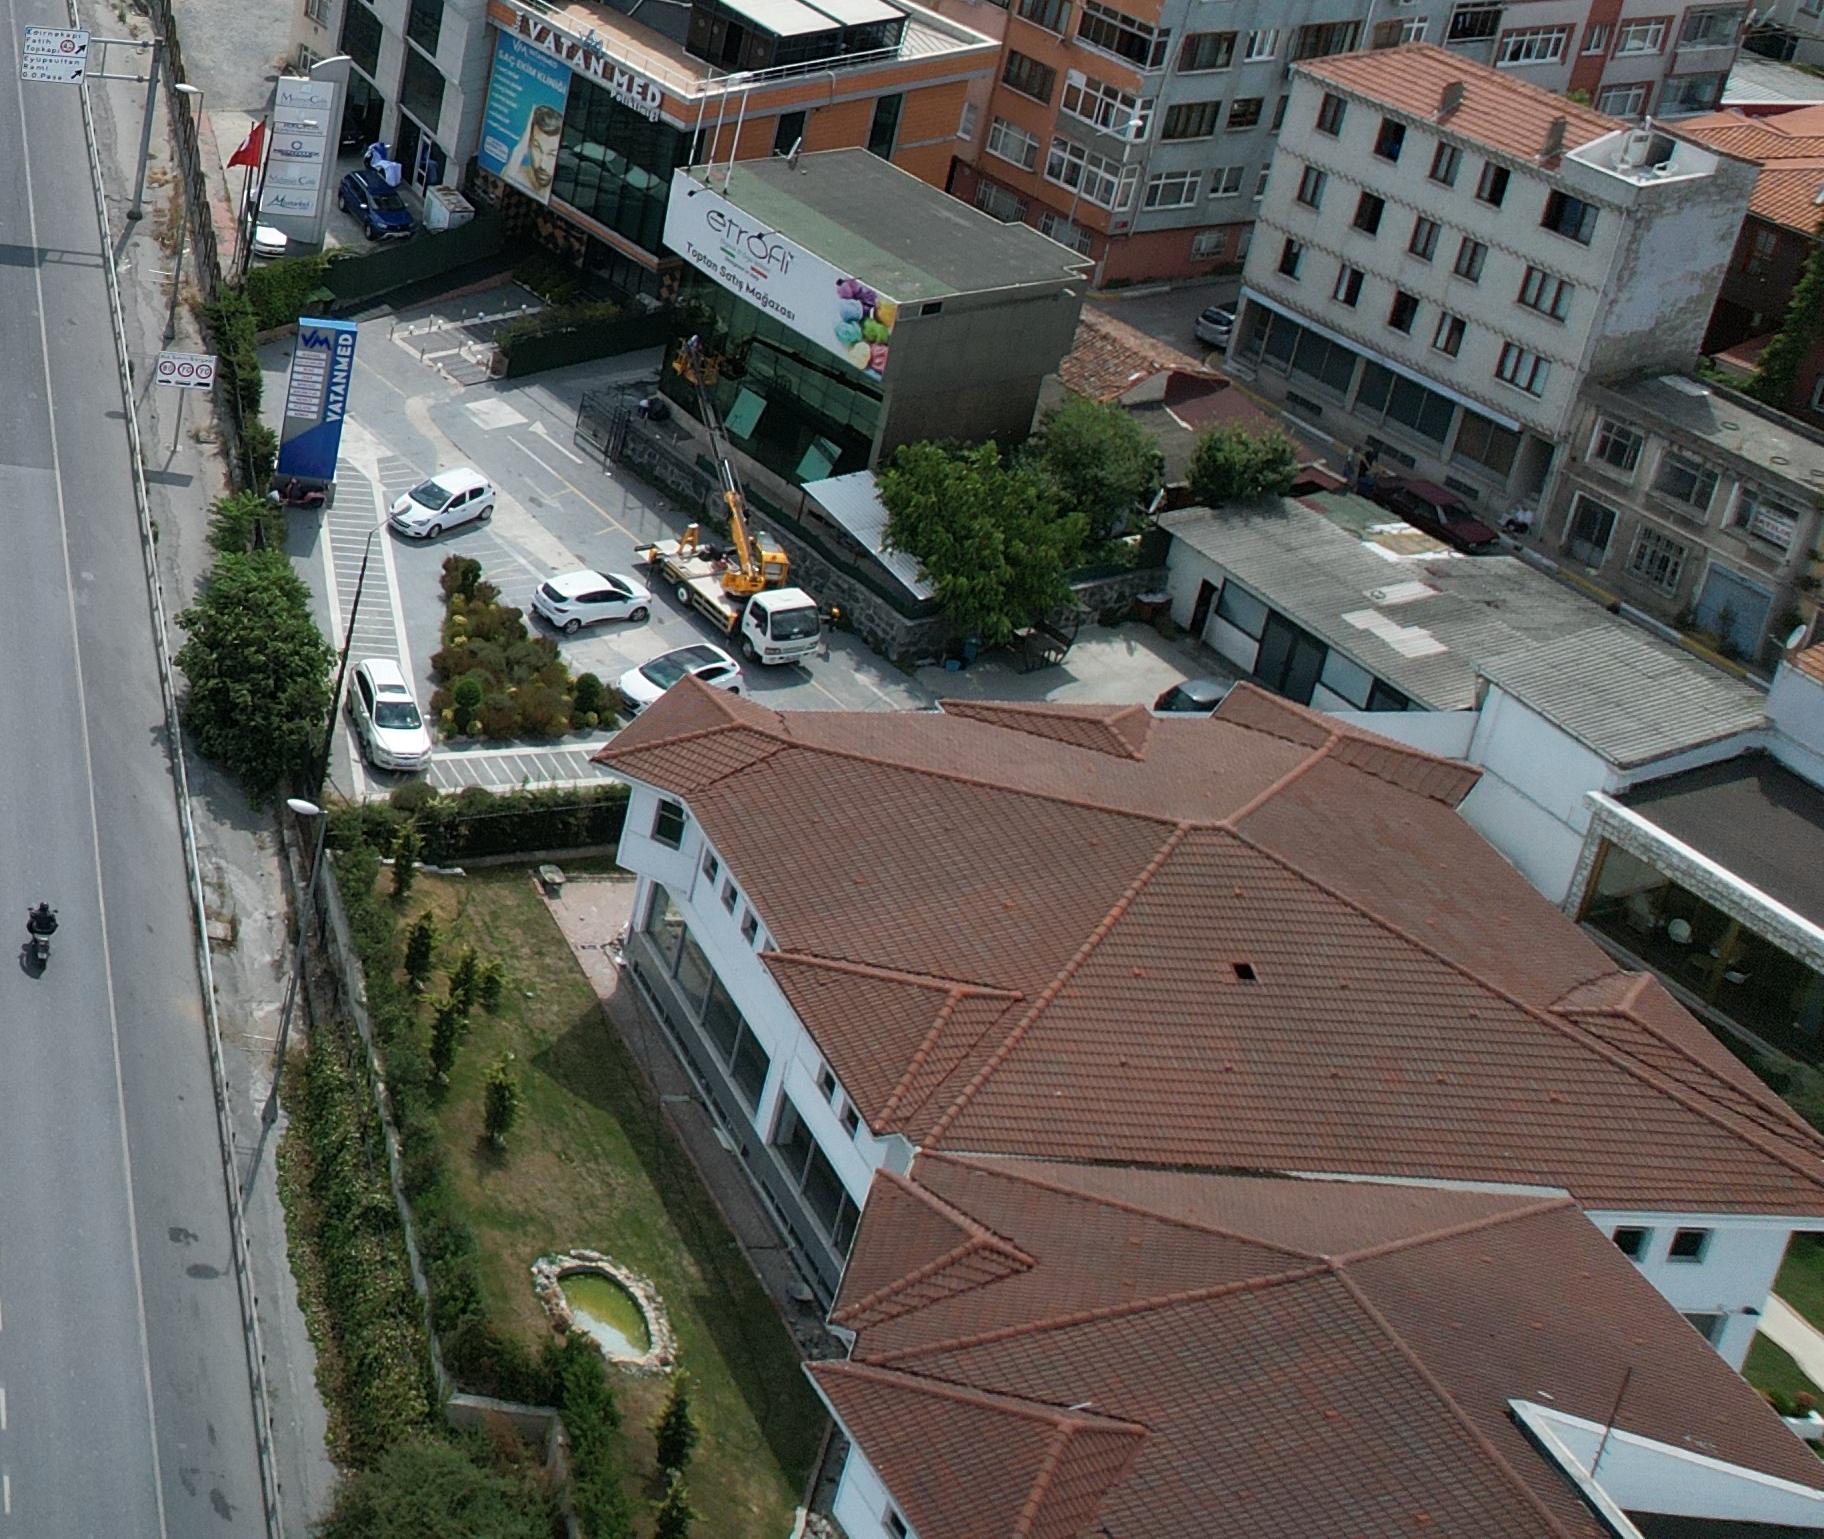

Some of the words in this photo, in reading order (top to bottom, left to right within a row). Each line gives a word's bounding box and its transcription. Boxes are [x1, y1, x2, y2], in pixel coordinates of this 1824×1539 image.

[27, 45, 60, 54] Topkapı
[498, 49, 515, 68] SAÇ
[516, 58, 537, 77] EKİM
[528, 18, 604, 79] VATAN
[613, 66, 662, 108] MED
[23, 63, 49, 71] Rami
[686, 241, 718, 272] Toptan
[720, 267, 743, 292] Satış
[745, 282, 796, 321] Mağazası
[302, 330, 332, 351] VM
[326, 333, 353, 422] VATANMED
